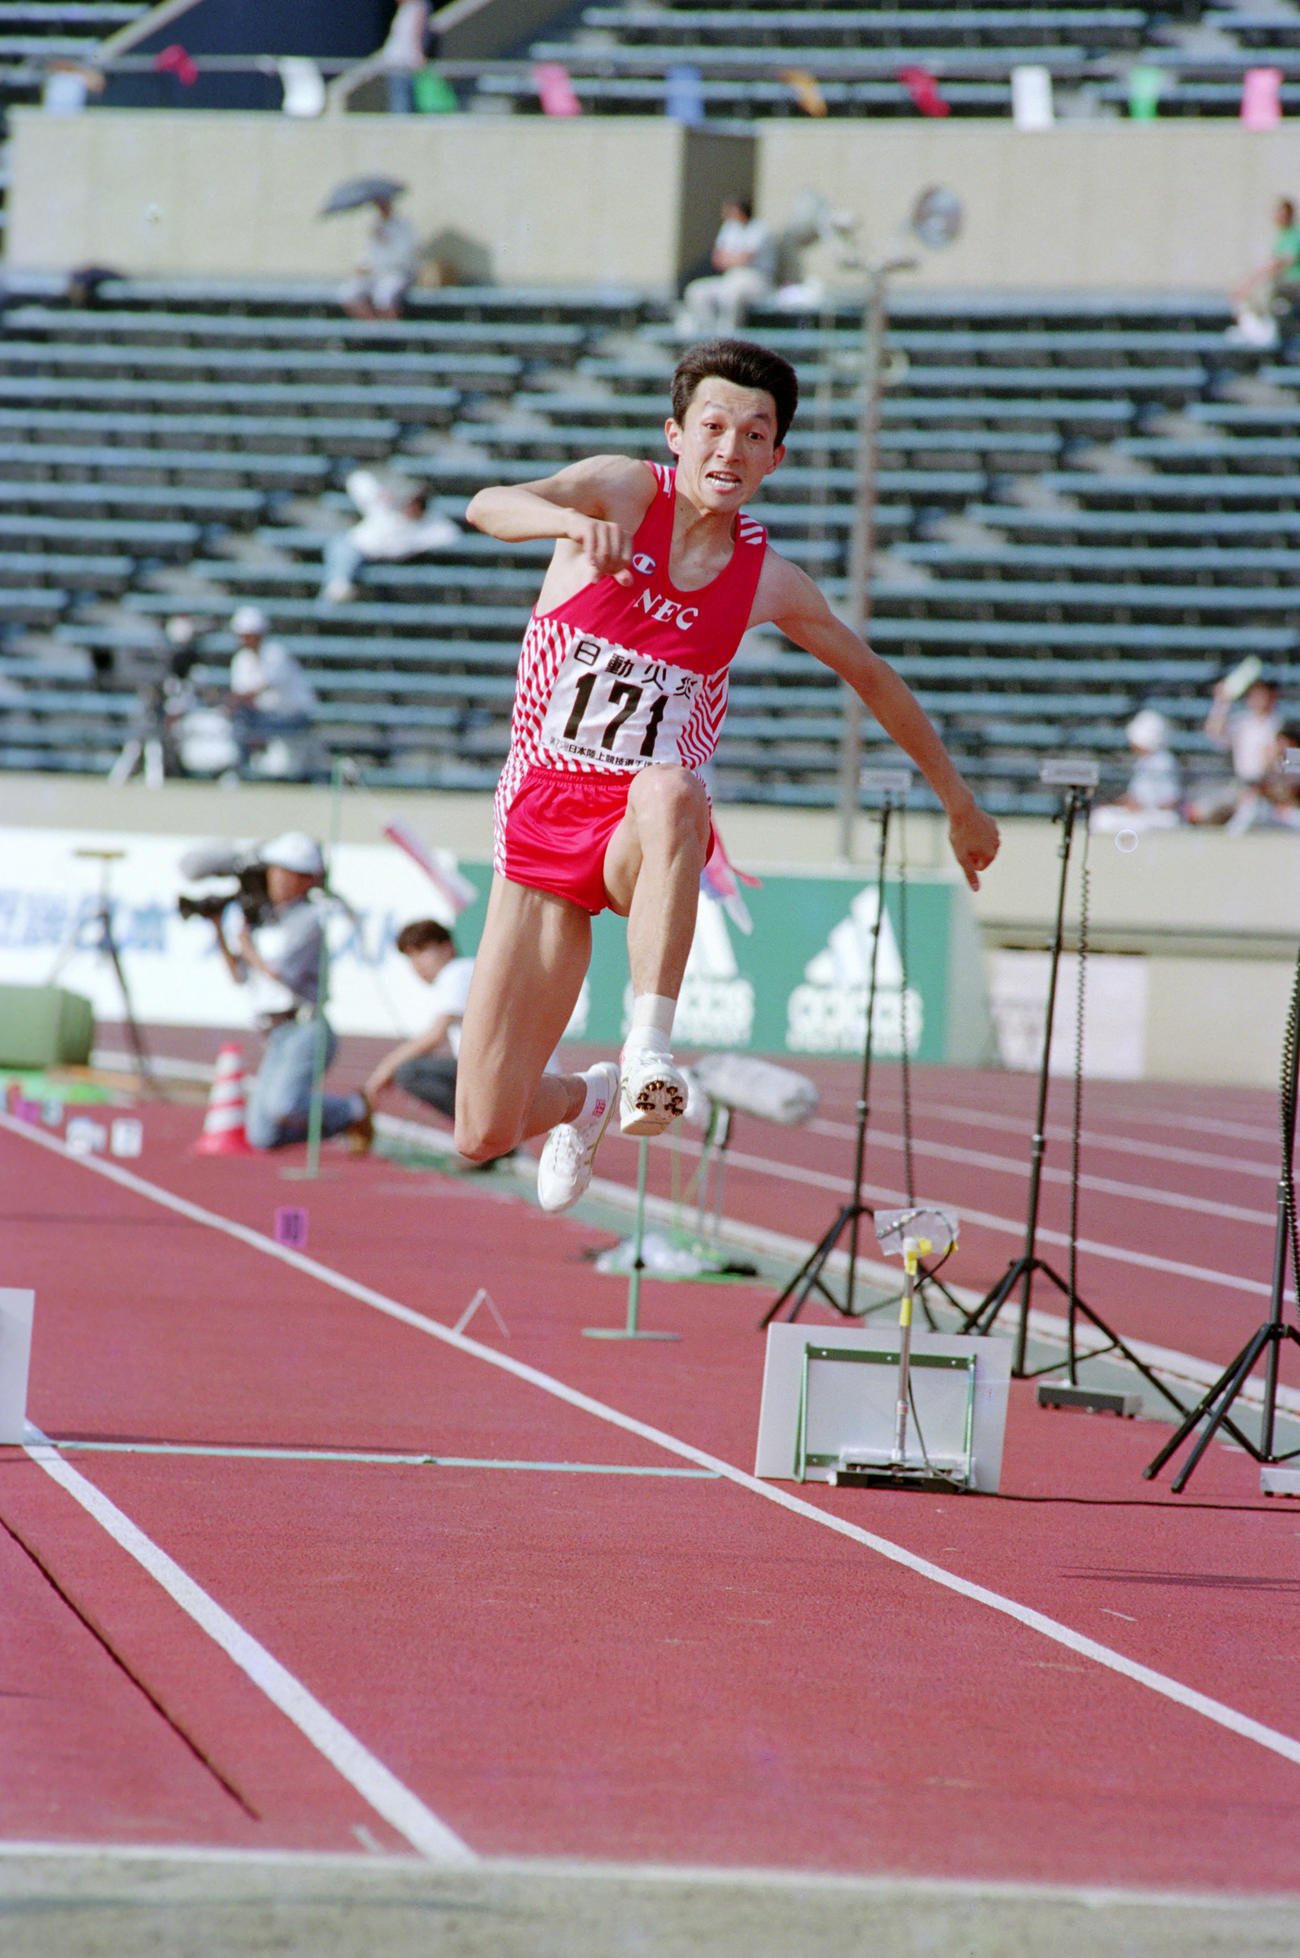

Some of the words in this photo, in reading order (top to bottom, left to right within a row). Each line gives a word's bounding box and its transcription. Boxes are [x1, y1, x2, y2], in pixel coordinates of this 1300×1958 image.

[633, 588, 699, 631] NEC
[574, 640, 697, 700] 日動火災
[563, 672, 669, 758] 171
